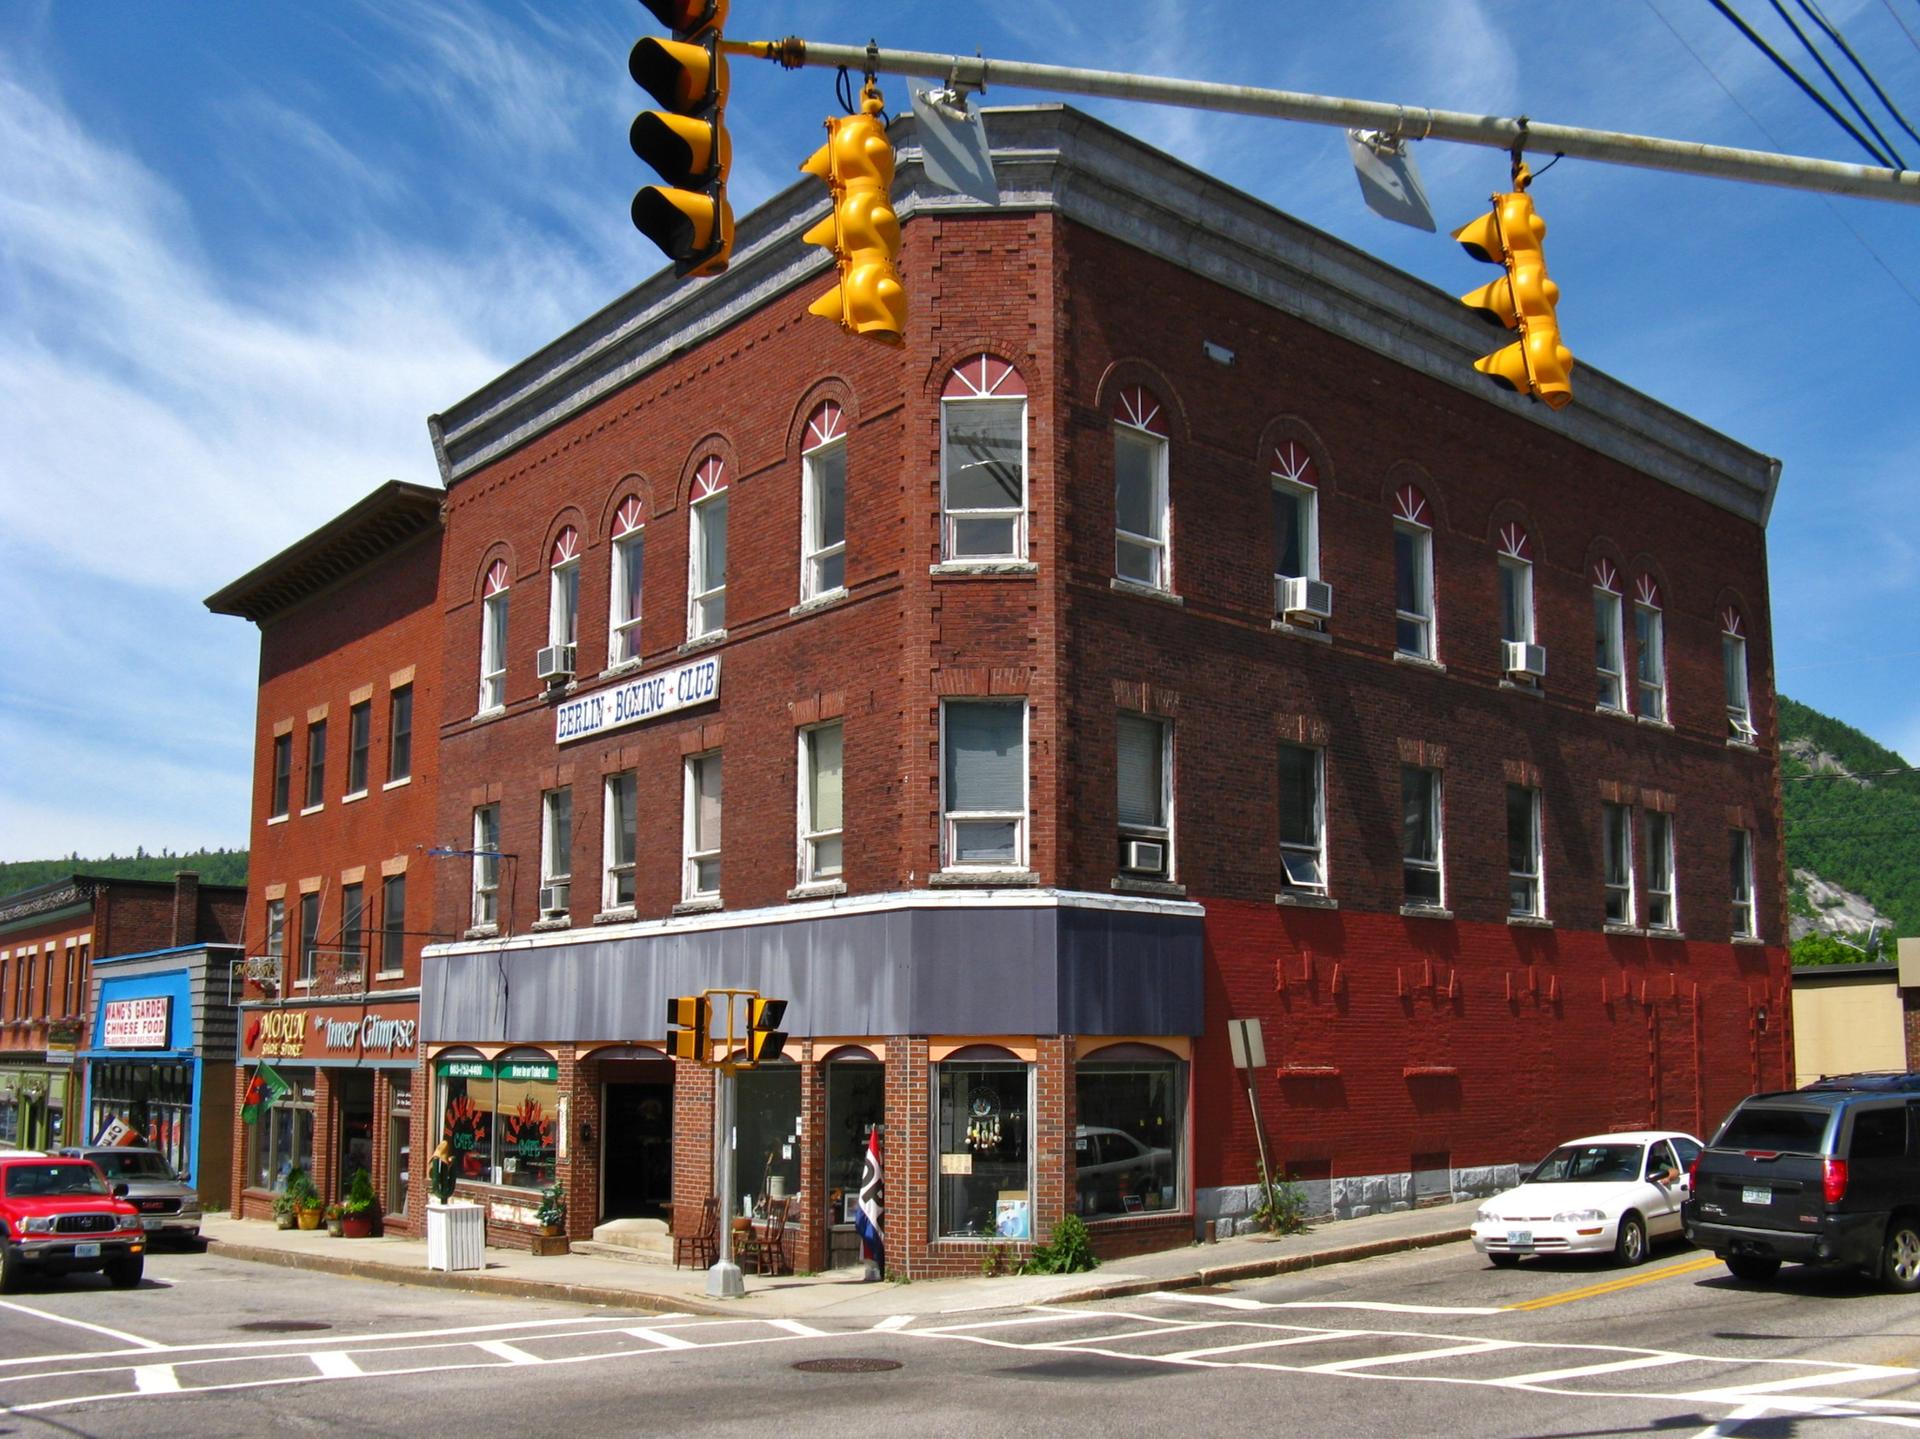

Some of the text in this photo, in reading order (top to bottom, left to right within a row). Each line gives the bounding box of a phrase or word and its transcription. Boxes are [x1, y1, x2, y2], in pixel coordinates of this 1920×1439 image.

[558, 661, 714, 738] BERLIN BOXING CLUB
[135, 999, 166, 1019] GARDEN
[106, 1020, 164, 1035] CHINESE FOOD
[260, 1010, 308, 1042] MORIN
[361, 1014, 416, 1054] Glimpse
[262, 1043, 304, 1056] SHOE STORE
